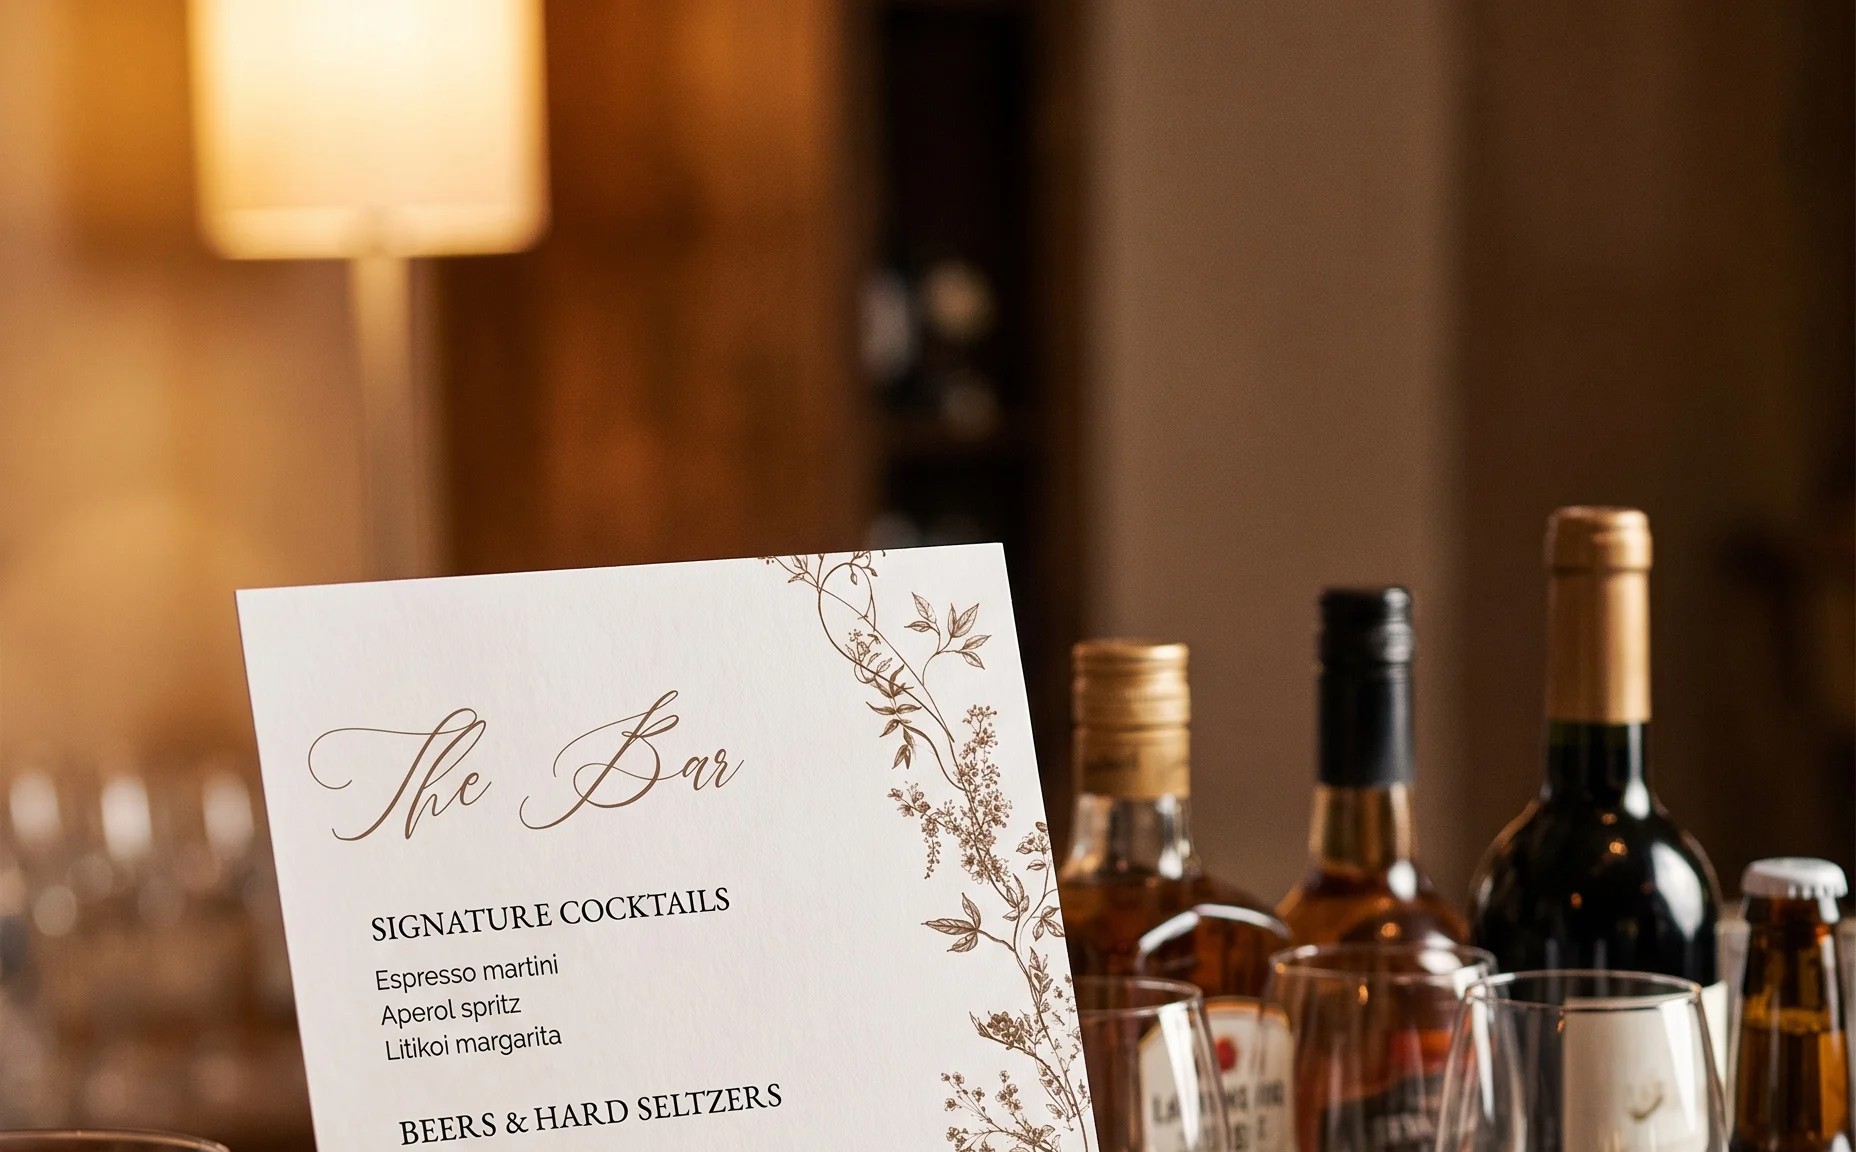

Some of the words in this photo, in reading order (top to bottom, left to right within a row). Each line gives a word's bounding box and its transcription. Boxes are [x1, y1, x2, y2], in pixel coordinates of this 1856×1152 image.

[308, 707, 492, 841] The
[519, 689, 745, 830] Bar
[371, 900, 553, 942] SIGNATURE
[559, 886, 730, 926] COCKTAILS
[375, 962, 477, 994] Espresso
[482, 952, 559, 981] martini
[380, 998, 457, 1030] Aperol
[460, 993, 522, 1023] spritz
[385, 1034, 450, 1061] Litikoi
[455, 1025, 563, 1056] margarita
[398, 1112, 497, 1146] BEERS
[505, 1111, 530, 1135] &
[532, 1099, 629, 1132] HARD
[637, 1082, 783, 1122] SELTZERS
